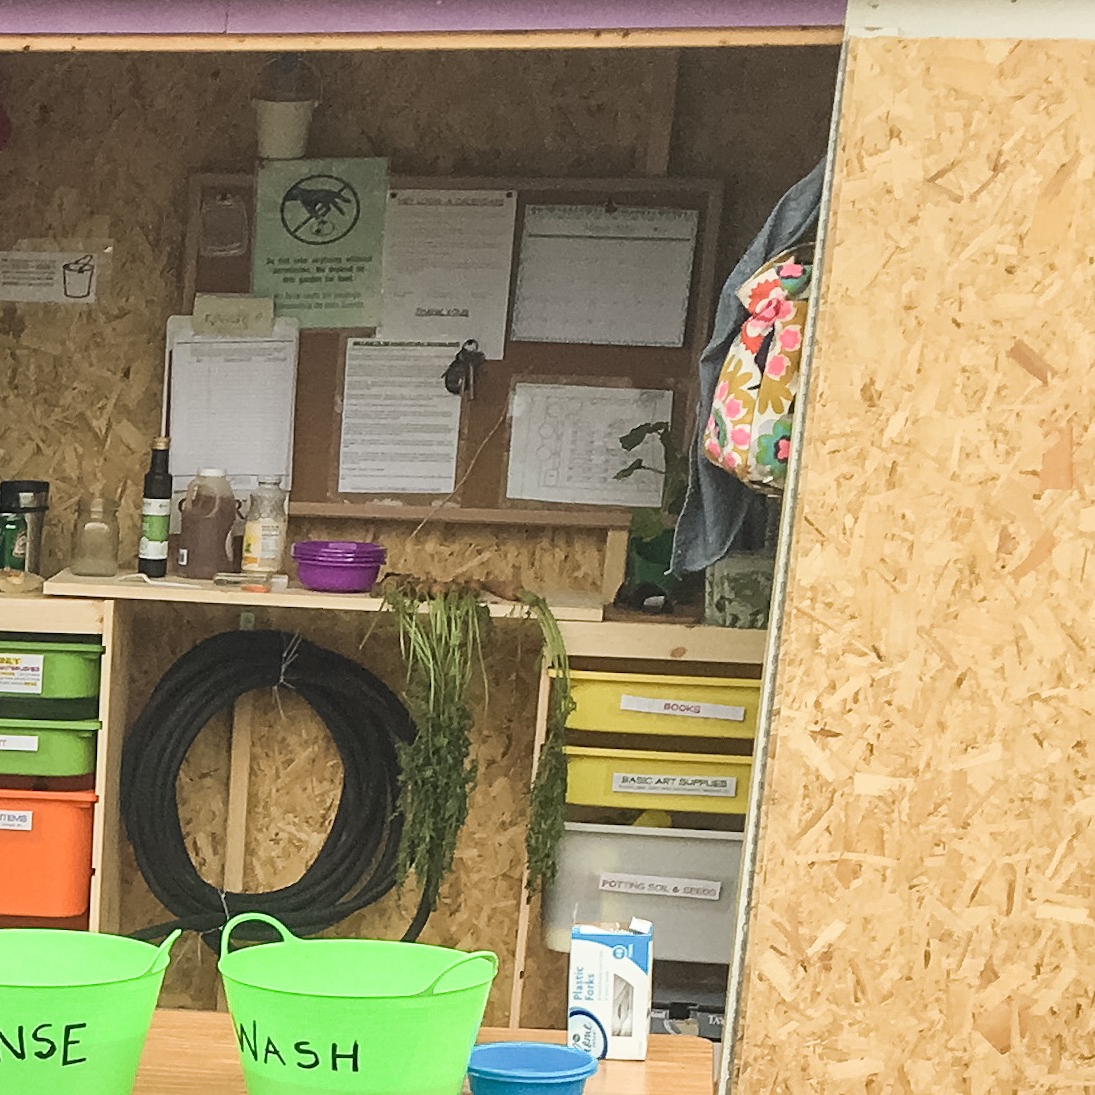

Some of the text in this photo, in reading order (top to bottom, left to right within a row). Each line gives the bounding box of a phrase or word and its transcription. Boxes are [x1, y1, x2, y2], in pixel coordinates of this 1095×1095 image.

[663, 702, 701, 714] BOOKS
[621, 775, 728, 788] BASIC ART SUPPLIES
[0, 814, 28, 823] ITEMS
[601, 879, 645, 891] POTTING
[647, 883, 669, 893] SOIL
[682, 887, 717, 896] SEEDS
[573, 966, 584, 1001] Plastic
[585, 973, 595, 1001] Forks
[234, 1018, 360, 1073] WASH
